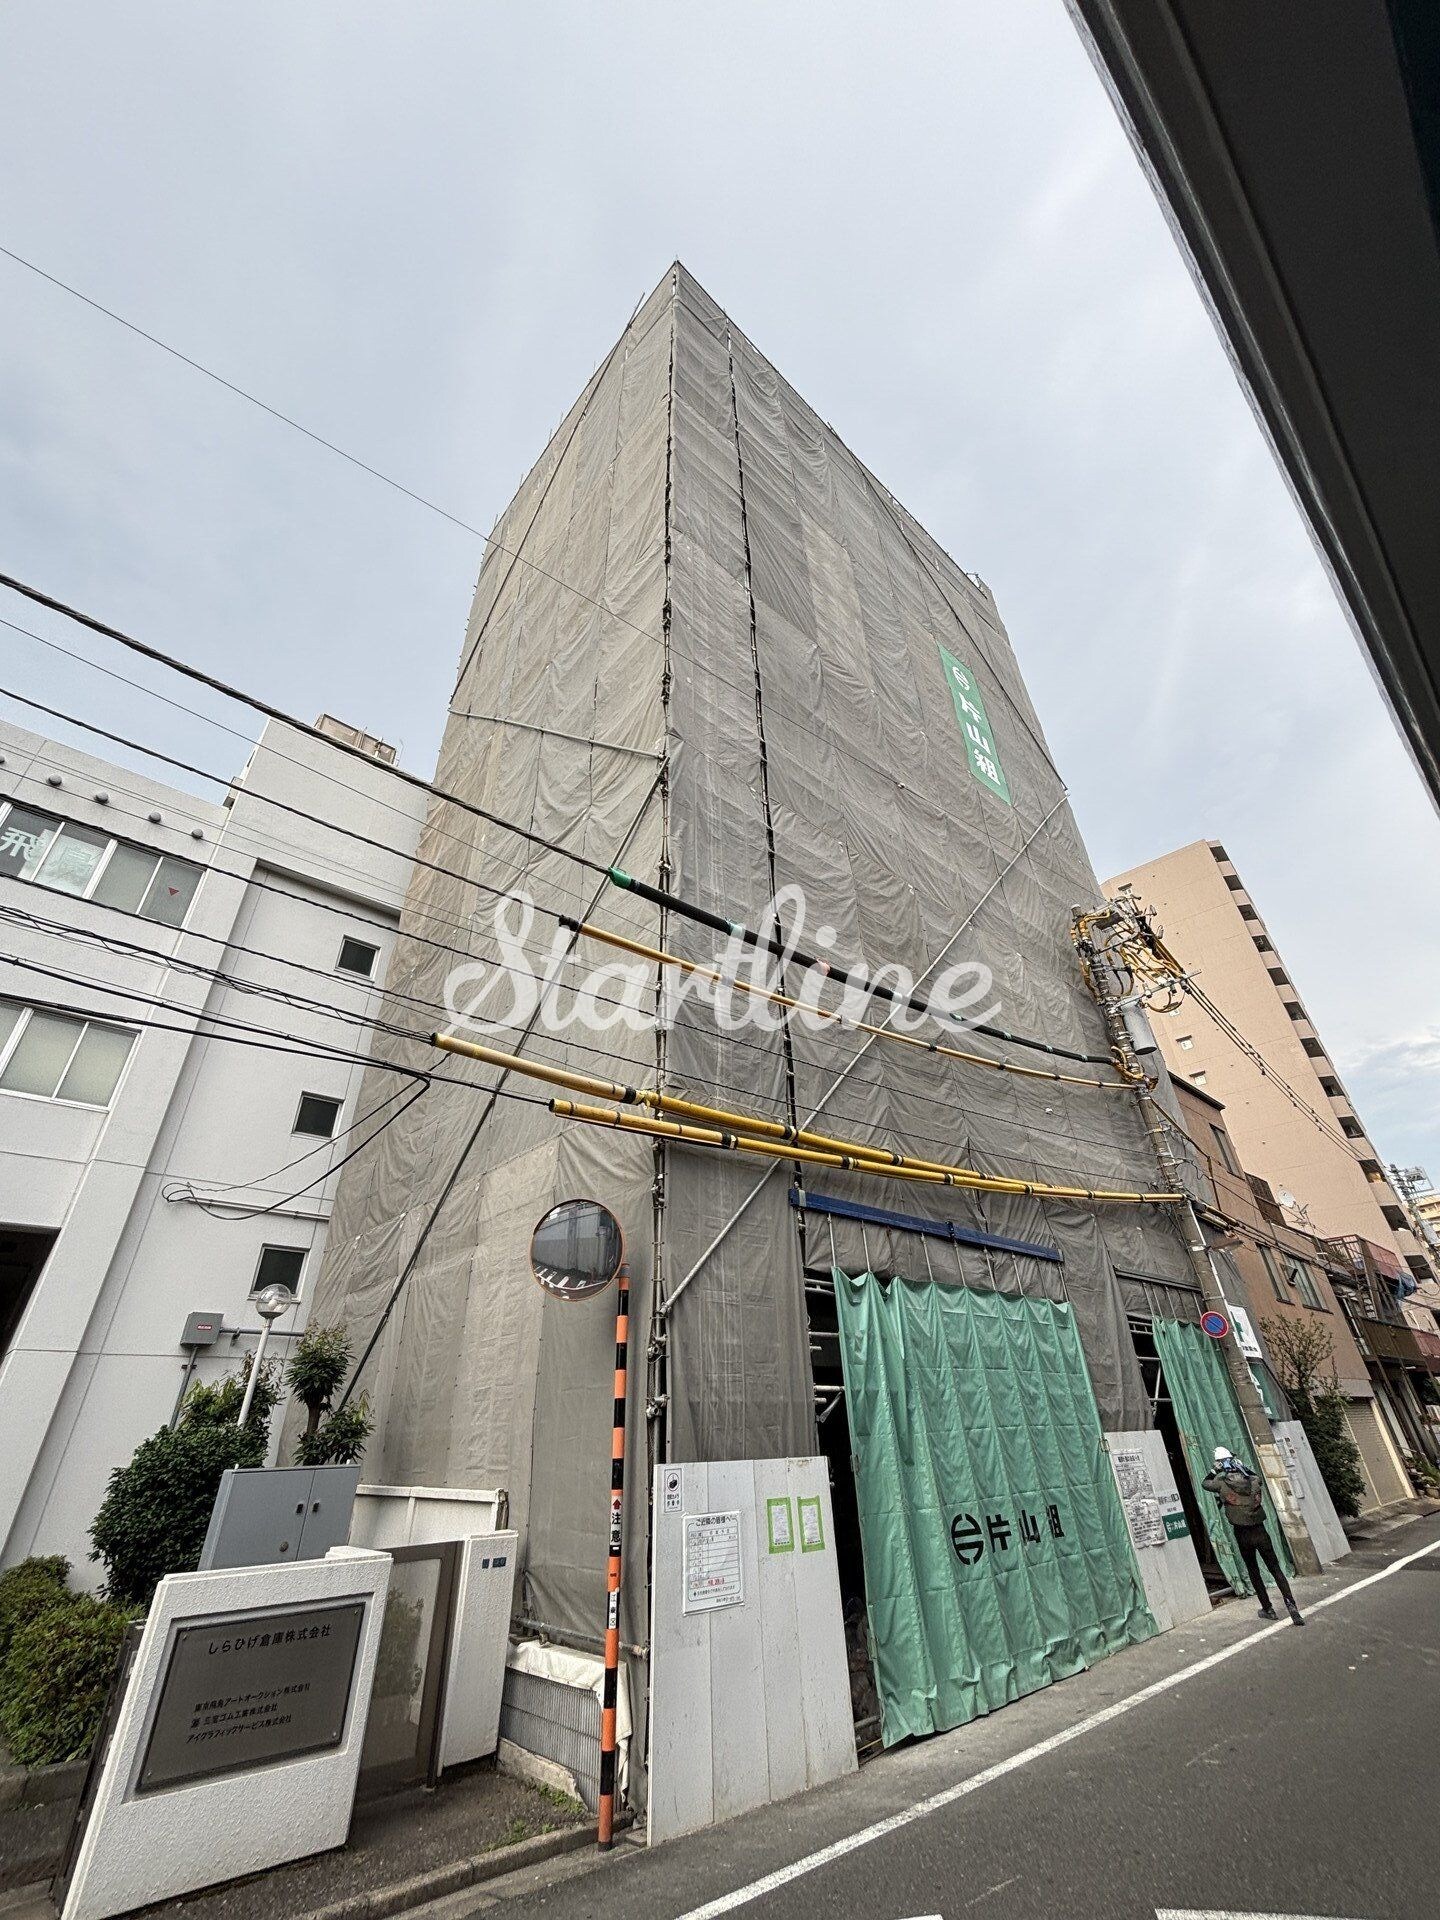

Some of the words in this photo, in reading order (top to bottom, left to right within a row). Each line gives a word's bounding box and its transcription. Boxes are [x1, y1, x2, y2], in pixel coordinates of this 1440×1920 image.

[611, 1512, 621, 1542] 注意
[208, 1624, 331, 1655] しらひげ倉庫株式会社
